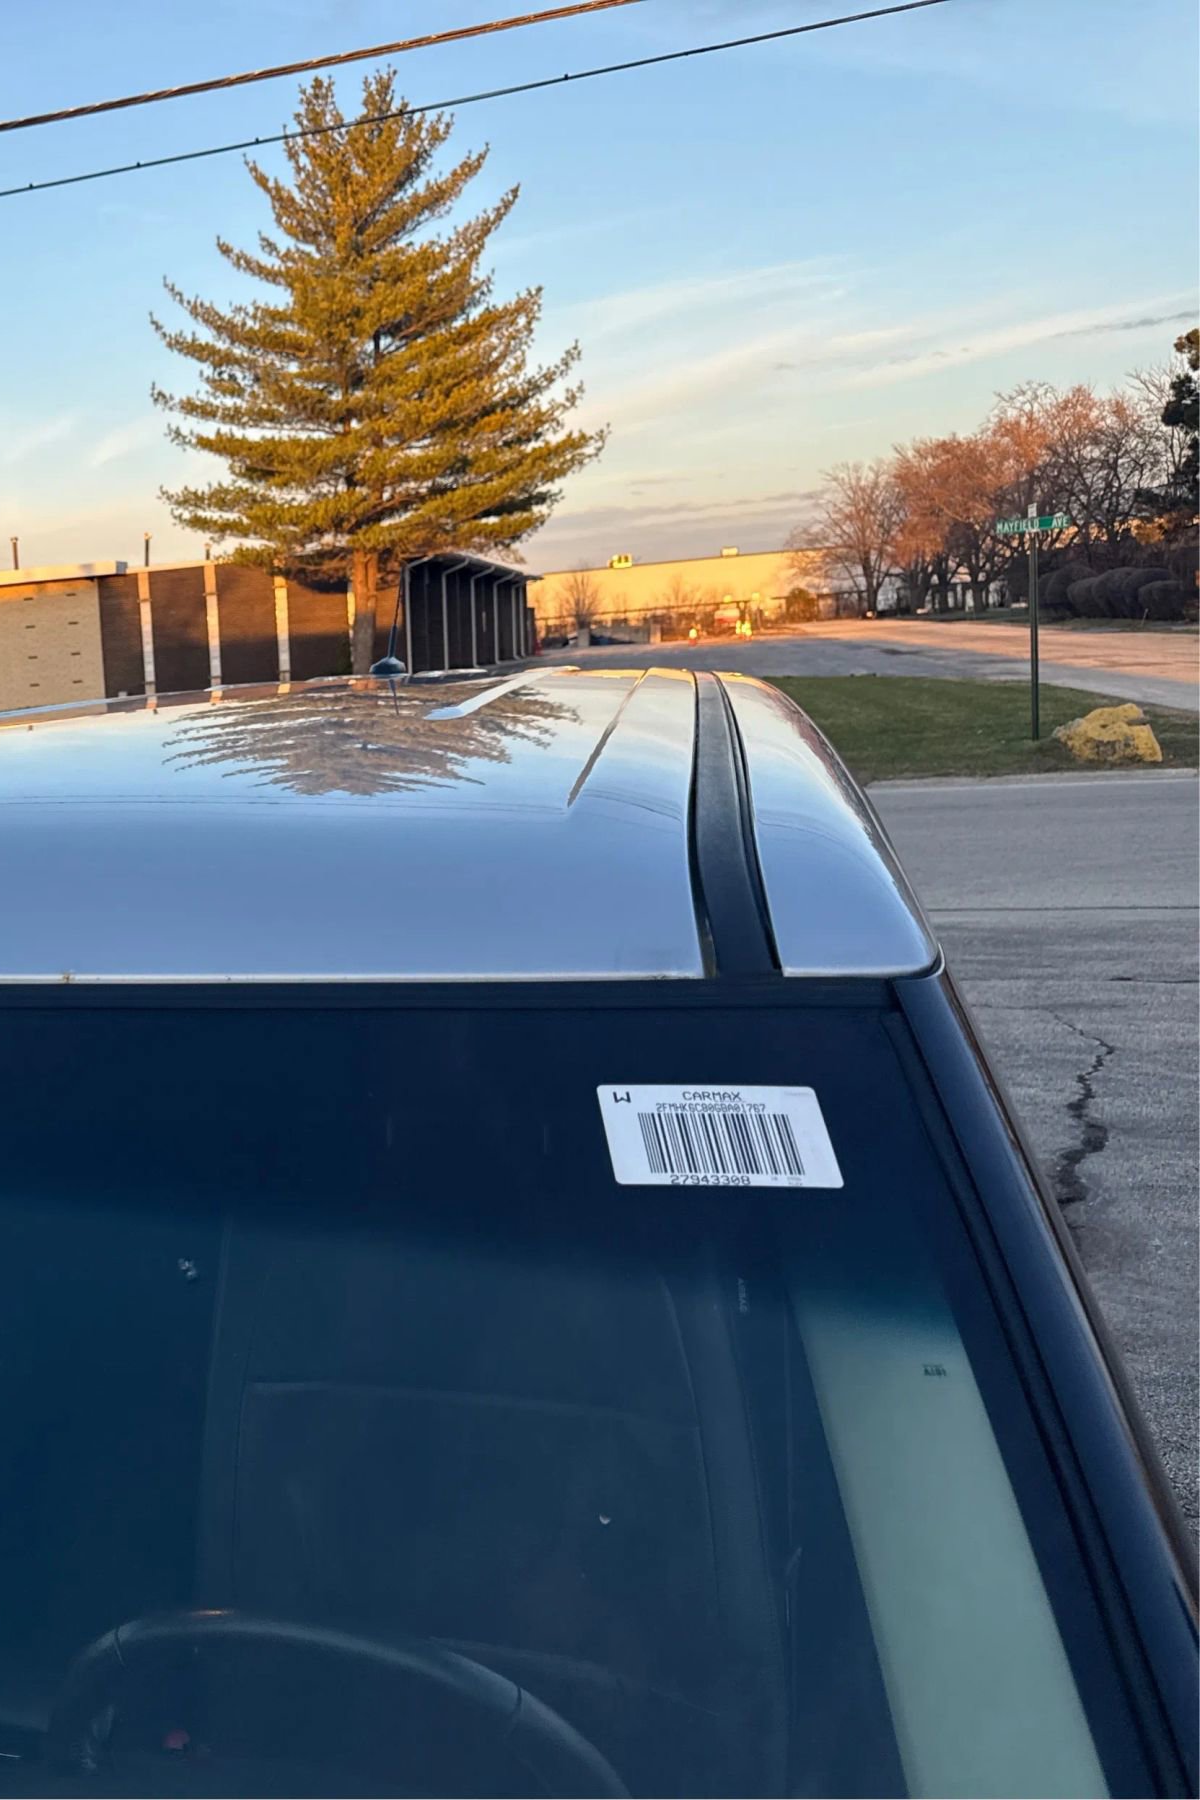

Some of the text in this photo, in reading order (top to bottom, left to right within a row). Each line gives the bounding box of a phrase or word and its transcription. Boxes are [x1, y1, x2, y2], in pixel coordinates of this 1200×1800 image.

[996, 516, 1067, 532] MAYFIELD AVE
[613, 1091, 631, 1103] W
[682, 1091, 743, 1102] CARMAX
[670, 1175, 751, 1185] 27943308
